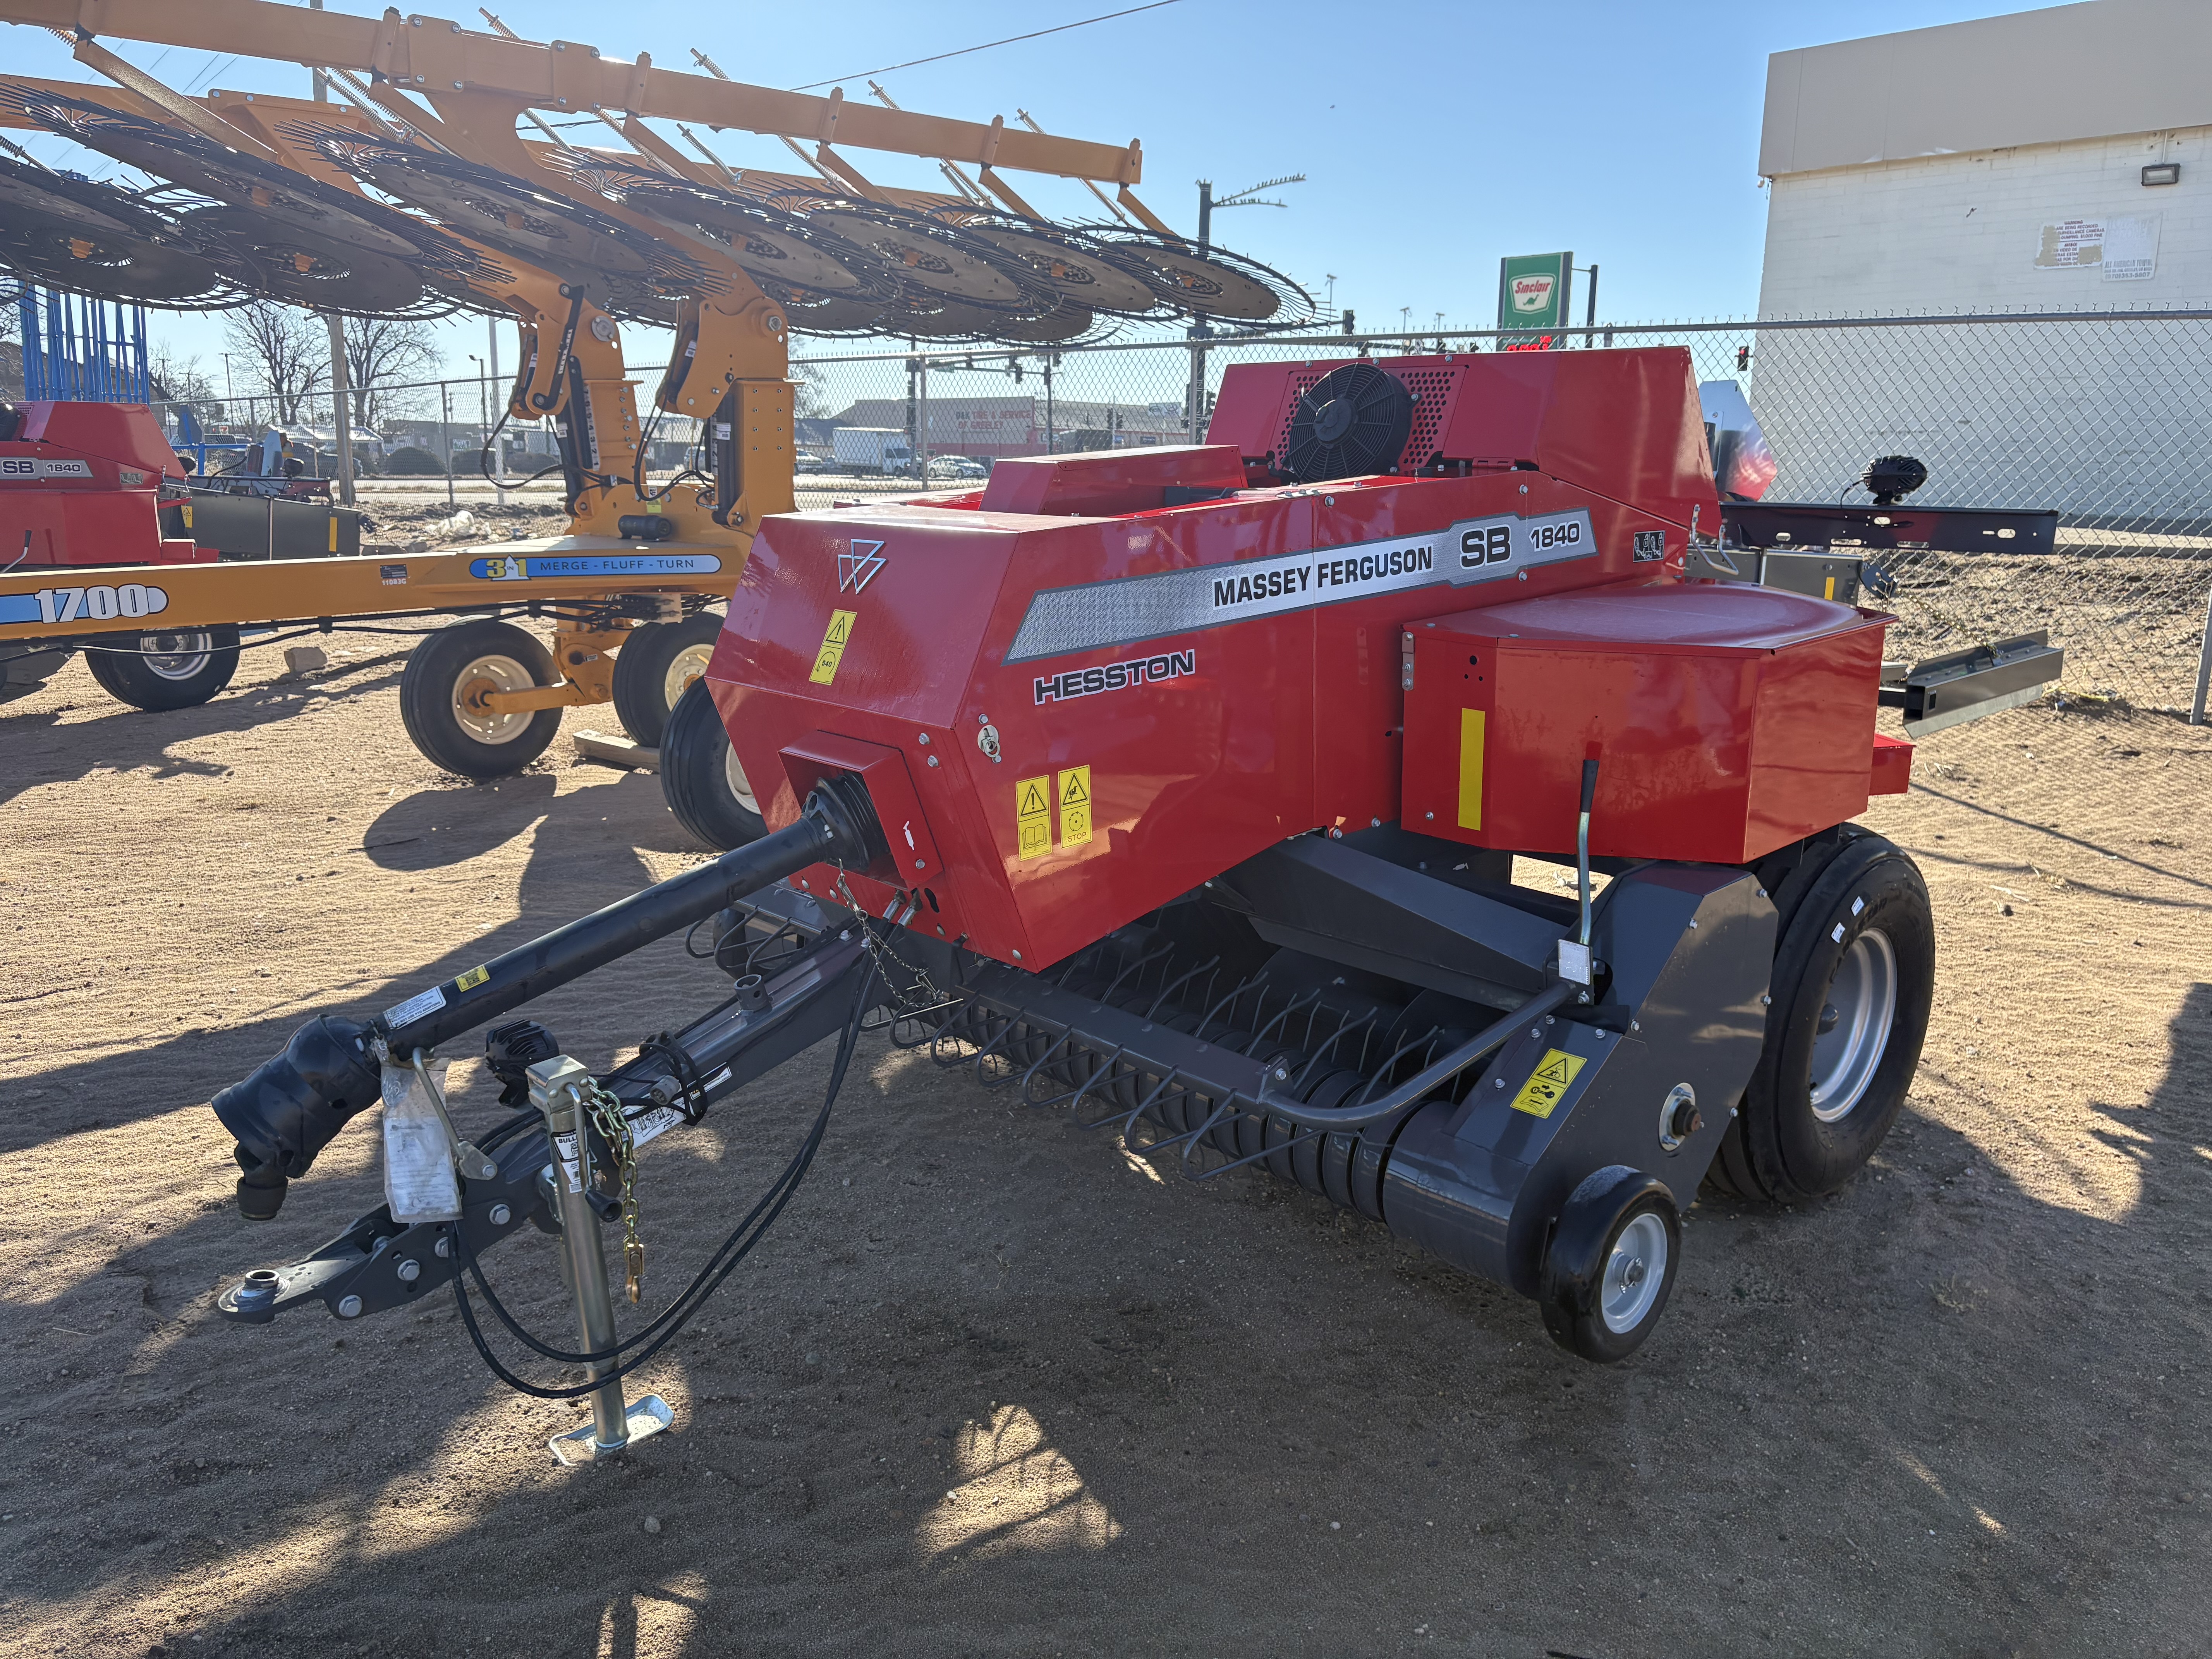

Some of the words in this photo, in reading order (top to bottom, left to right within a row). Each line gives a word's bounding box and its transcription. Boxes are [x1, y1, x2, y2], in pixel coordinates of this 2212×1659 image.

[1515, 280, 1550, 294] Sinclair
[2, 460, 34, 474] SB
[46, 464, 82, 473] 1840
[540, 561, 588, 570] MERGE
[603, 560, 644, 570] FLUFF
[658, 559, 694, 568] TURN
[1214, 566, 1311, 607] MASSEY
[1317, 546, 1432, 588] FERGUSON
[1460, 526, 1511, 569] SB
[1530, 521, 1581, 551] 1840
[34, 584, 150, 623] 1700
[1035, 651, 1194, 704] HESSTON
[1068, 831, 1086, 842] STOP
